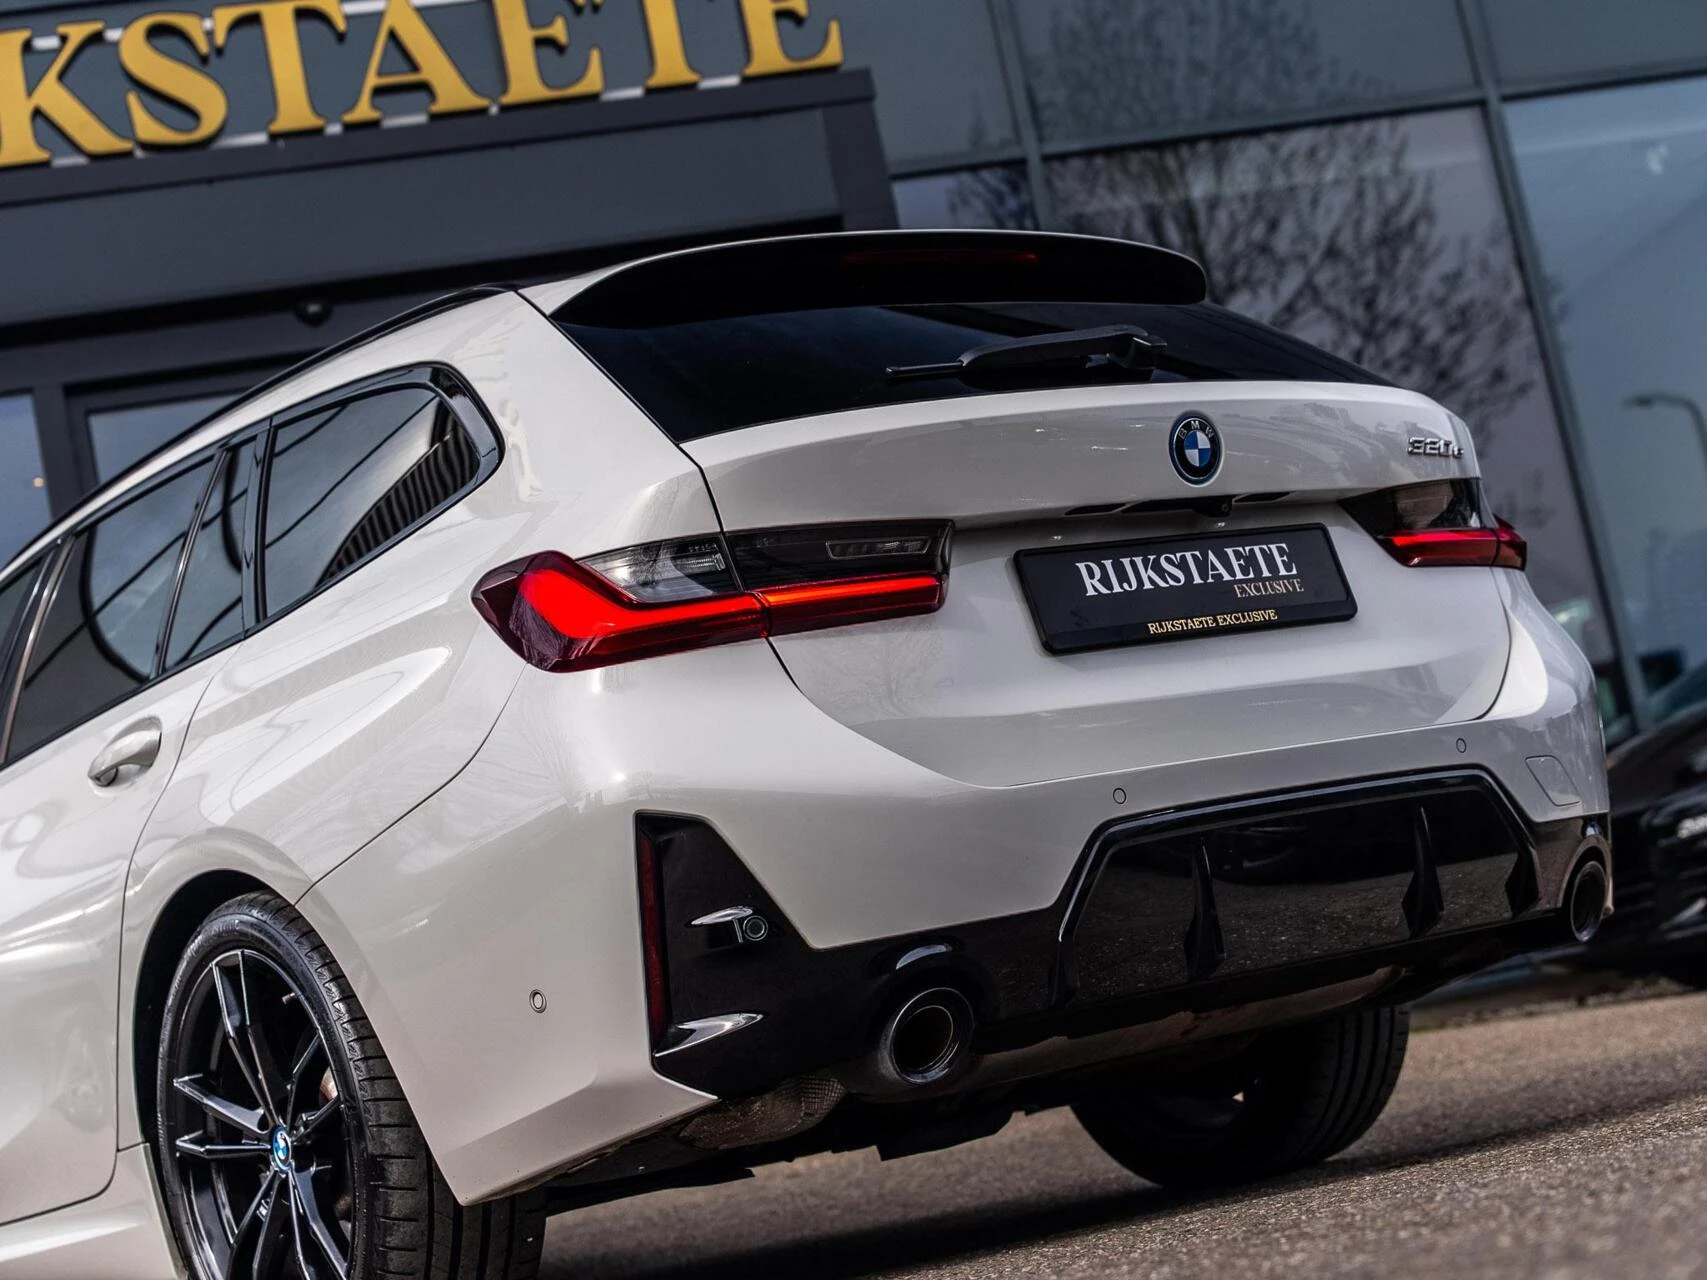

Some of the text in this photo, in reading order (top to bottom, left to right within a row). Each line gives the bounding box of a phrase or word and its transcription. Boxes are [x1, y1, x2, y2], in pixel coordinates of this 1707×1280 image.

[1178, 420, 1215, 439] BMW
[1075, 543, 1298, 596] RIJKSTAETE
[1233, 578, 1304, 598] EXCLUSIVE
[1147, 609, 1278, 634] RIJKSTAETE EXCLUSIVE
